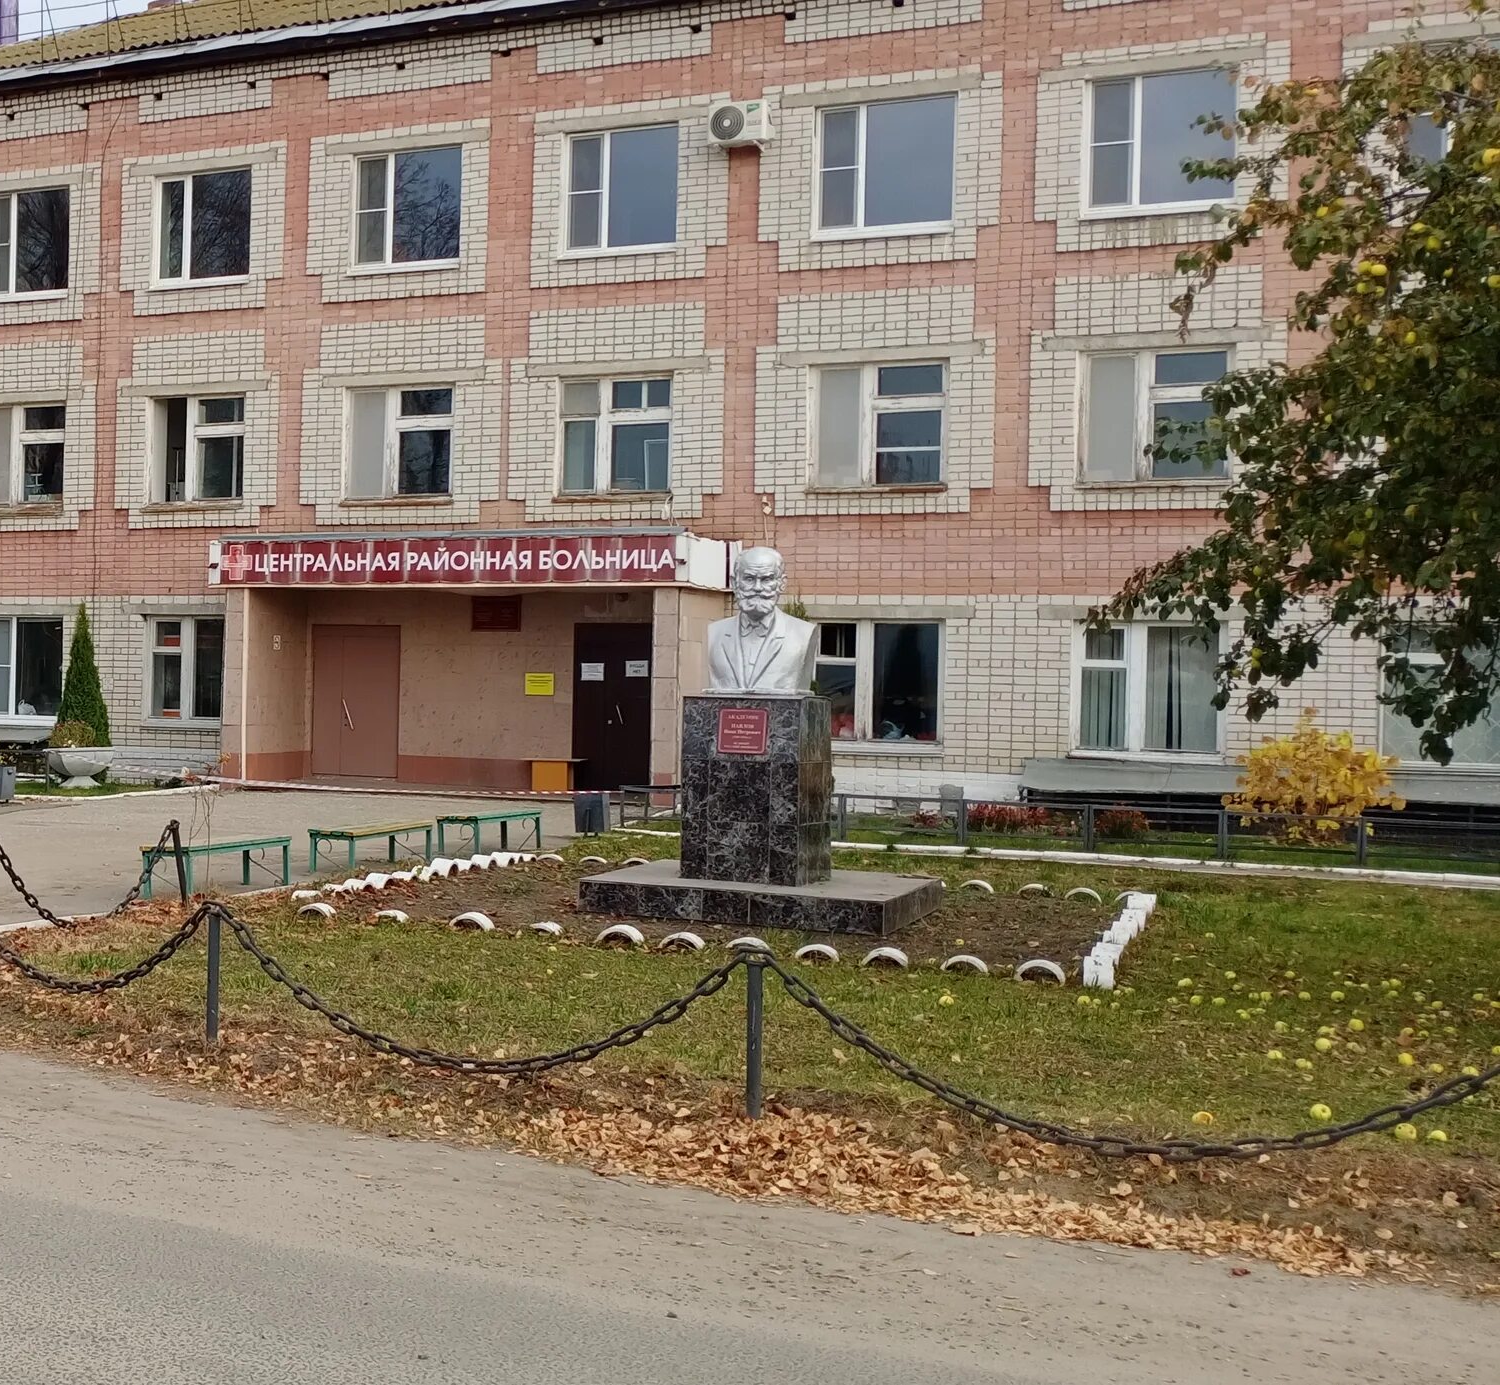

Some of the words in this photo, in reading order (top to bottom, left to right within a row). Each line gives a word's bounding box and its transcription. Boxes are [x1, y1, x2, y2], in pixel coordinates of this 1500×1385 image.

[255, 552, 399, 575] ЦЕНТРАЛЬНАЯ
[407, 547, 532, 571] РАЙОННАЯ
[538, 548, 676, 572] БОЛЬНИЦА
